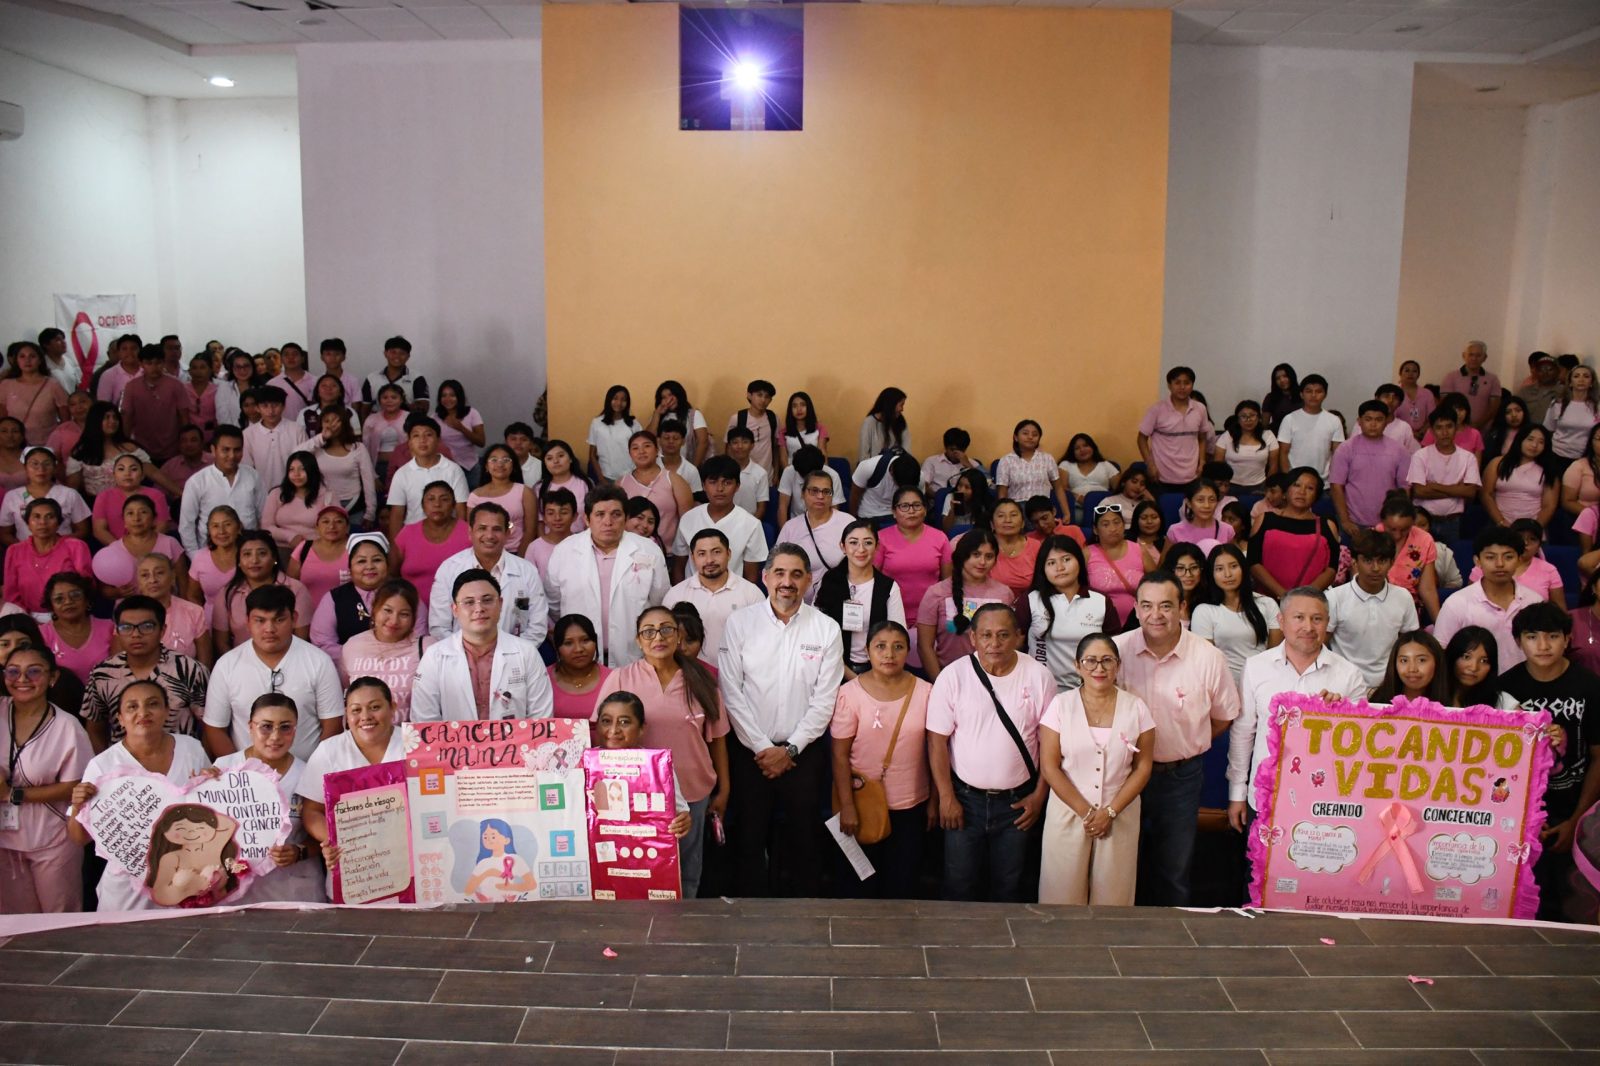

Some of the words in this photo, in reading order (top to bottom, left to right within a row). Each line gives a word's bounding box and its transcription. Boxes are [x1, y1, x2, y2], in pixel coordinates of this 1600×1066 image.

[98, 314, 136, 327] OCTUBRE
[353, 656, 411, 671] HOWDY
[531, 719, 558, 740] DE
[1303, 718, 1523, 768] TOCANDO
[1334, 760, 1486, 805] VIDAS
[91, 799, 113, 813] Tus
[111, 780, 135, 800] manos
[197, 788, 259, 804] MUNDIAL
[335, 801, 363, 814] Factores
[365, 796, 373, 808] de
[374, 797, 395, 809] riesgo
[93, 807, 117, 830] pueden
[98, 817, 119, 839] primer
[119, 801, 135, 819] paso
[135, 784, 153, 807] para
[227, 803, 269, 819] CONTRA
[1312, 803, 1363, 817] CREANDO
[1423, 808, 1493, 825] CONCIENCIA
[101, 822, 124, 846] proteger
[125, 812, 136, 821] tu
[107, 830, 129, 853] conoce
[139, 797, 162, 820] cuerpo
[115, 831, 141, 858] escucha
[139, 819, 153, 830] tus
[243, 832, 259, 844] DE
[1462, 904, 1470, 914] de
